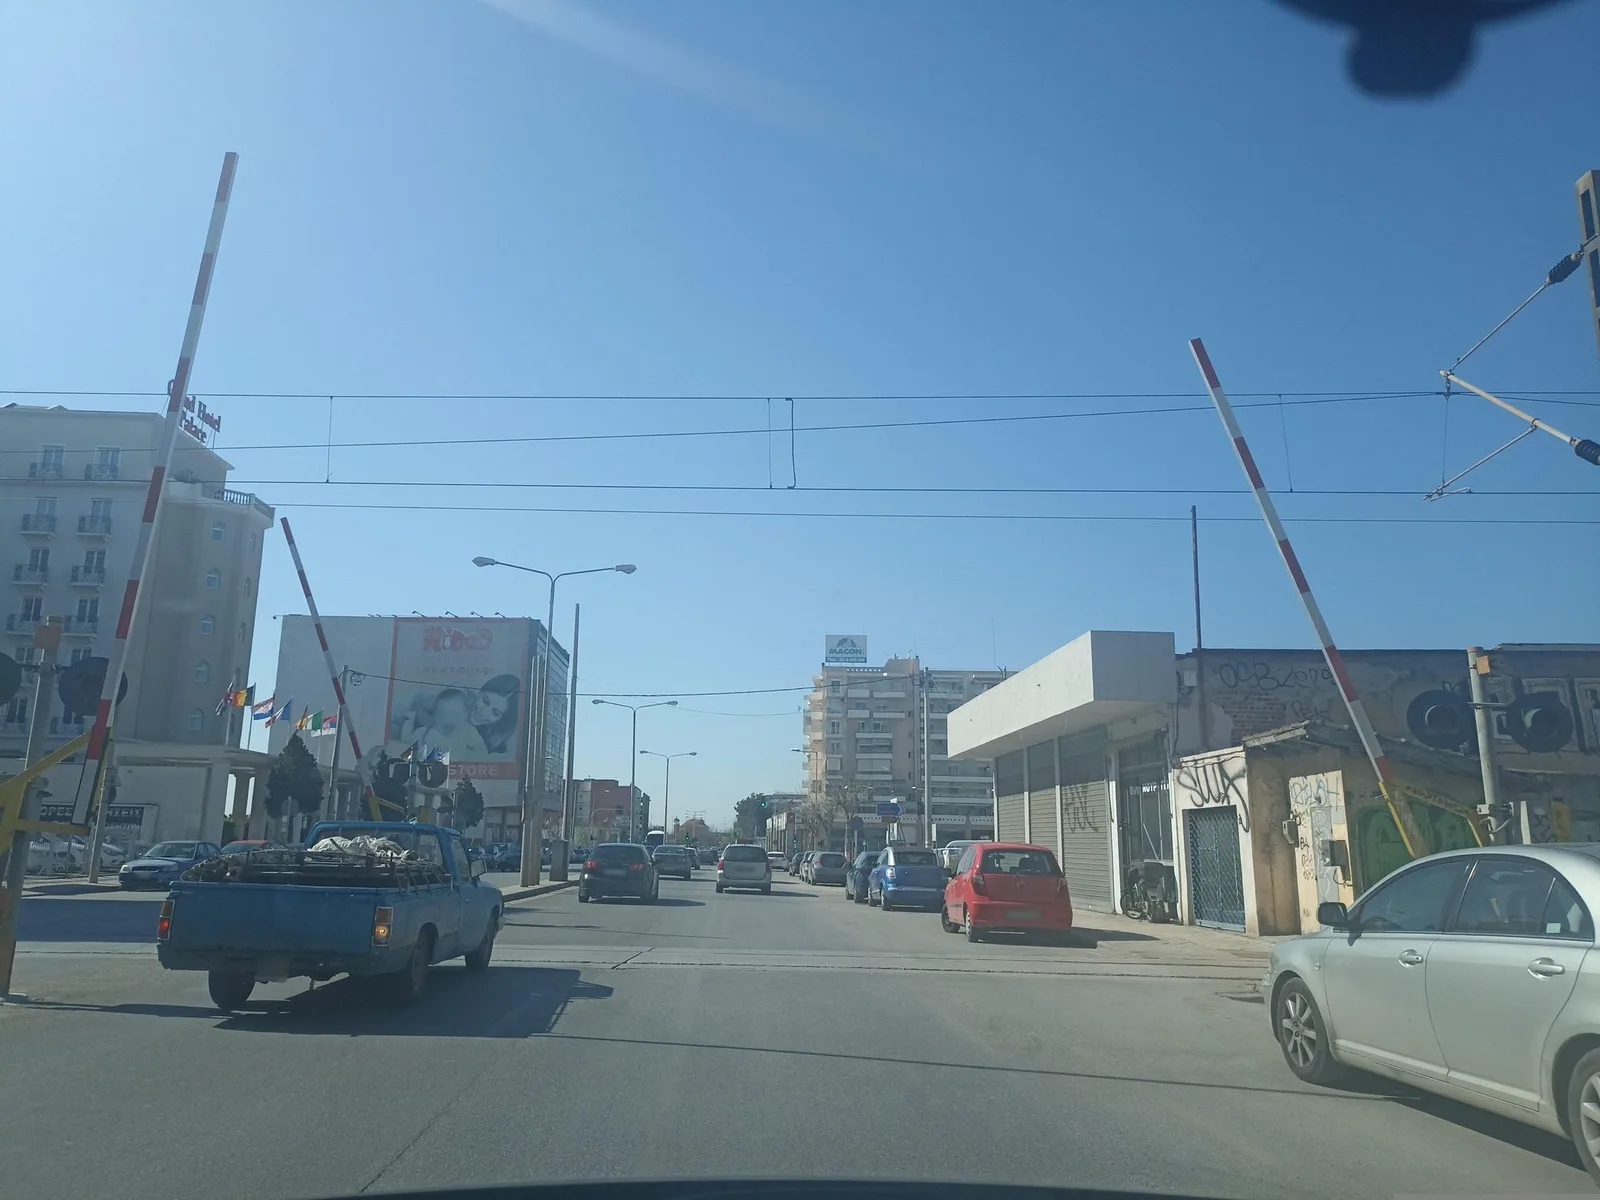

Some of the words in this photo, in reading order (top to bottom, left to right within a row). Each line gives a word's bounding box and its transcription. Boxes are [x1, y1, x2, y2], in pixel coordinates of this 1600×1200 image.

[197, 401, 221, 433] Hotel
[449, 764, 499, 776] STORE
[40, 806, 73, 816] ΟΡΕΣ
